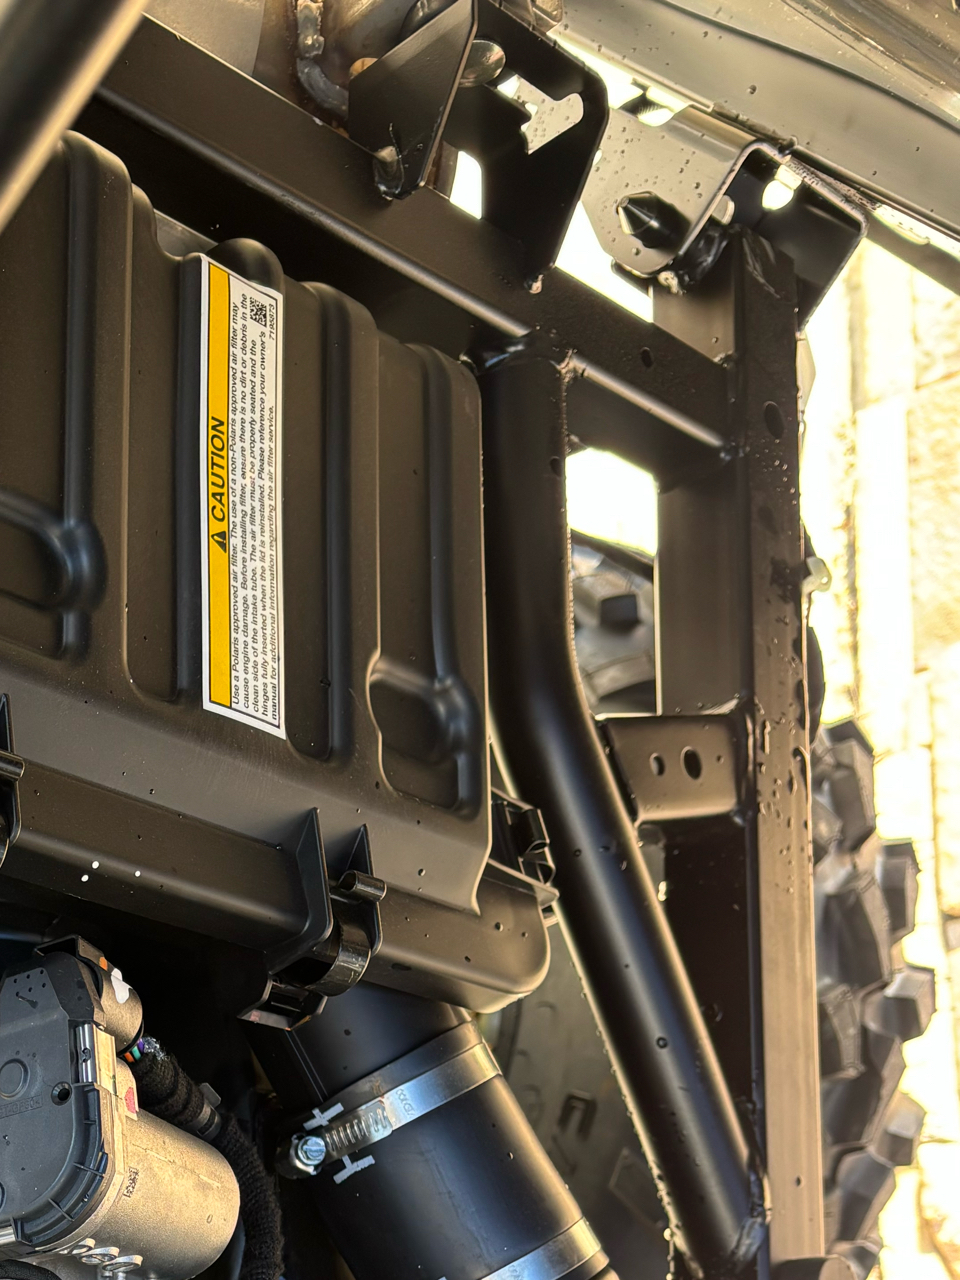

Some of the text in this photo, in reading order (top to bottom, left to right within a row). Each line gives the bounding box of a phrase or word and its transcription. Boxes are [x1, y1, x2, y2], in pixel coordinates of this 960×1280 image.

[232, 301, 240, 325] may
[240, 293, 248, 309] the
[240, 311, 247, 322] in
[249, 339, 257, 357] the
[240, 356, 247, 369] or
[249, 357, 257, 378] and
[230, 366, 238, 416] approved
[239, 370, 247, 388] dirt
[259, 371, 267, 397] your
[240, 390, 247, 404] no
[239, 406, 246, 415] is
[258, 397, 266, 445] reference
[238, 417, 246, 444] there
[248, 416, 257, 460] properly
[229, 418, 237, 476] non-Polaris
[210, 415, 225, 522] CAUTION
[249, 460, 256, 474] be
[230, 486, 237, 498] of
[258, 483, 266, 538] reinstalled.
[230, 520, 238, 539] The
[240, 509, 248, 554] installing
[249, 528, 257, 542] air
[267, 504, 276, 552] regarding
[230, 543, 238, 567] filter.
[249, 544, 257, 563] The
[259, 539, 266, 549] is
[230, 569, 238, 583] air
[240, 556, 248, 591] Before
[250, 566, 258, 592] tube.
[259, 565, 267, 582] the
[268, 553, 276, 611] information
[231, 585, 240, 634] approved
[241, 594, 250, 638] damage.
[260, 613, 268, 657] inserted
[269, 612, 277, 664] additional
[231, 637, 239, 672] Polaris
[242, 640, 250, 675] engine
[251, 646, 259, 658] of
[251, 659, 259, 682] side
[261, 657, 269, 680] fully
[269, 664, 277, 680] for
[232, 685, 240, 705] Use
[251, 684, 259, 713] clean
[261, 681, 269, 717] hinges
[269, 682, 277, 720] manual
